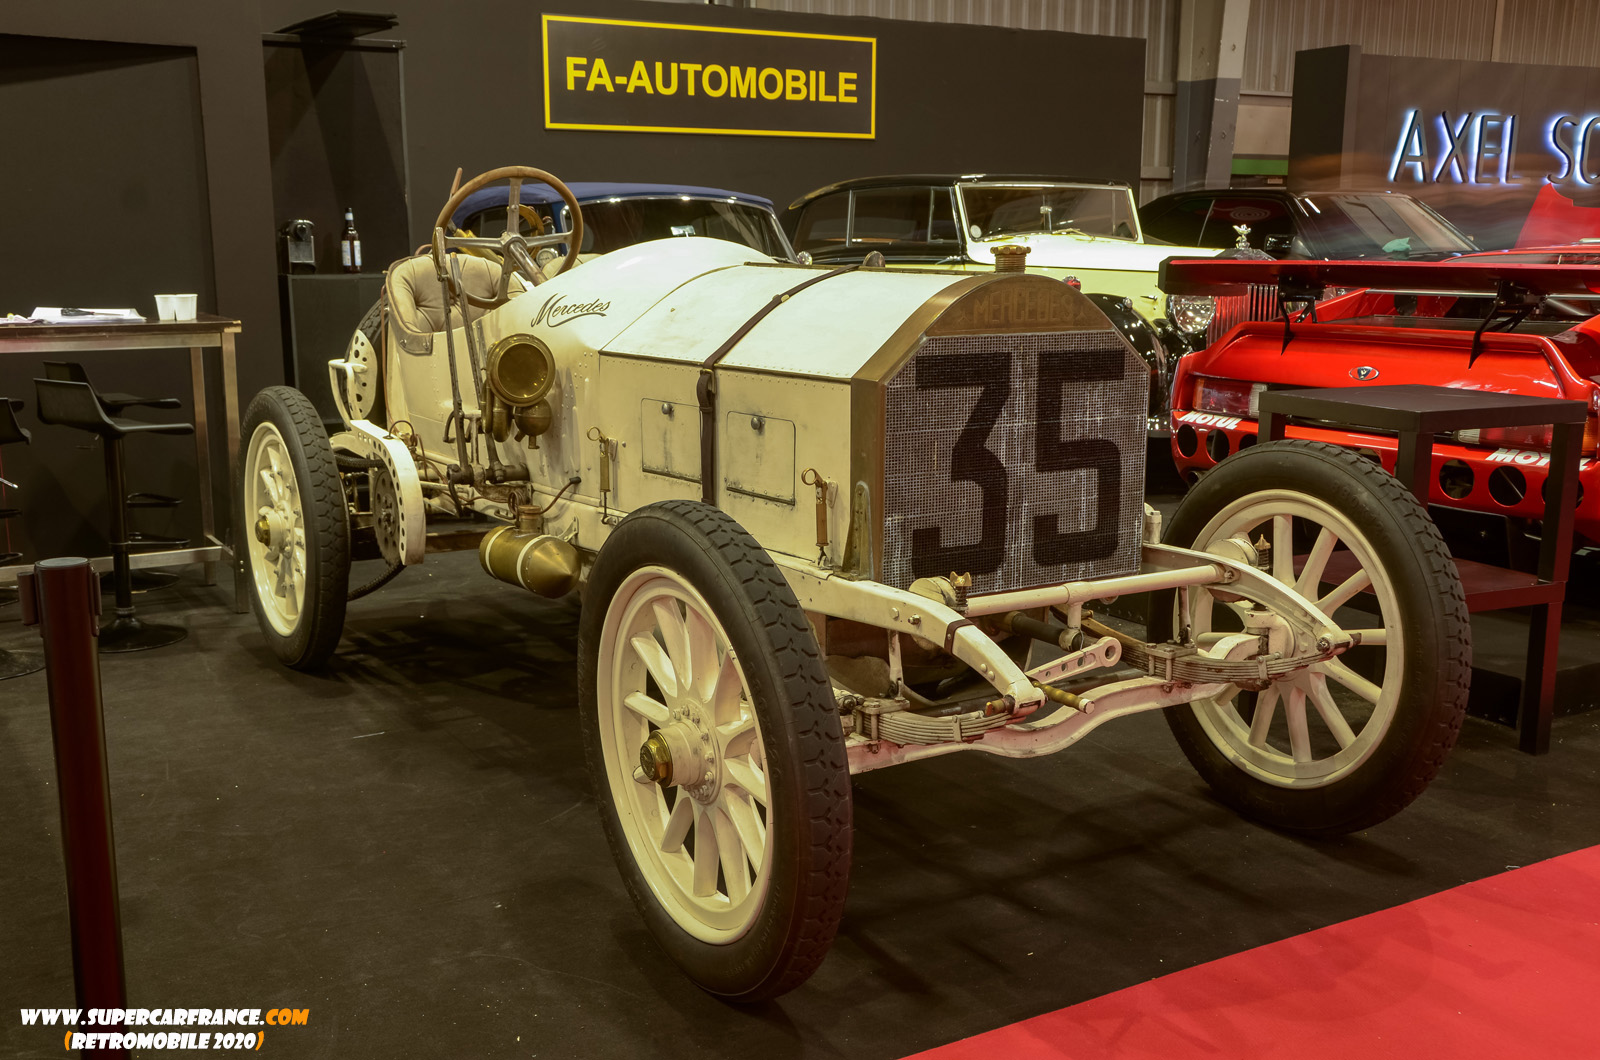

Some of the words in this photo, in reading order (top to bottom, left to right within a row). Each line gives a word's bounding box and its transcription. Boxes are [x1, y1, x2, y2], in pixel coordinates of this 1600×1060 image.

[566, 56, 857, 103] FA-AUTOMOBILE
[1391, 109, 1531, 184] AXEL
[530, 293, 611, 328] Mercedes
[973, 287, 1074, 327] MERCEDES
[1177, 411, 1242, 430] MOTUL
[911, 349, 1126, 581] 35
